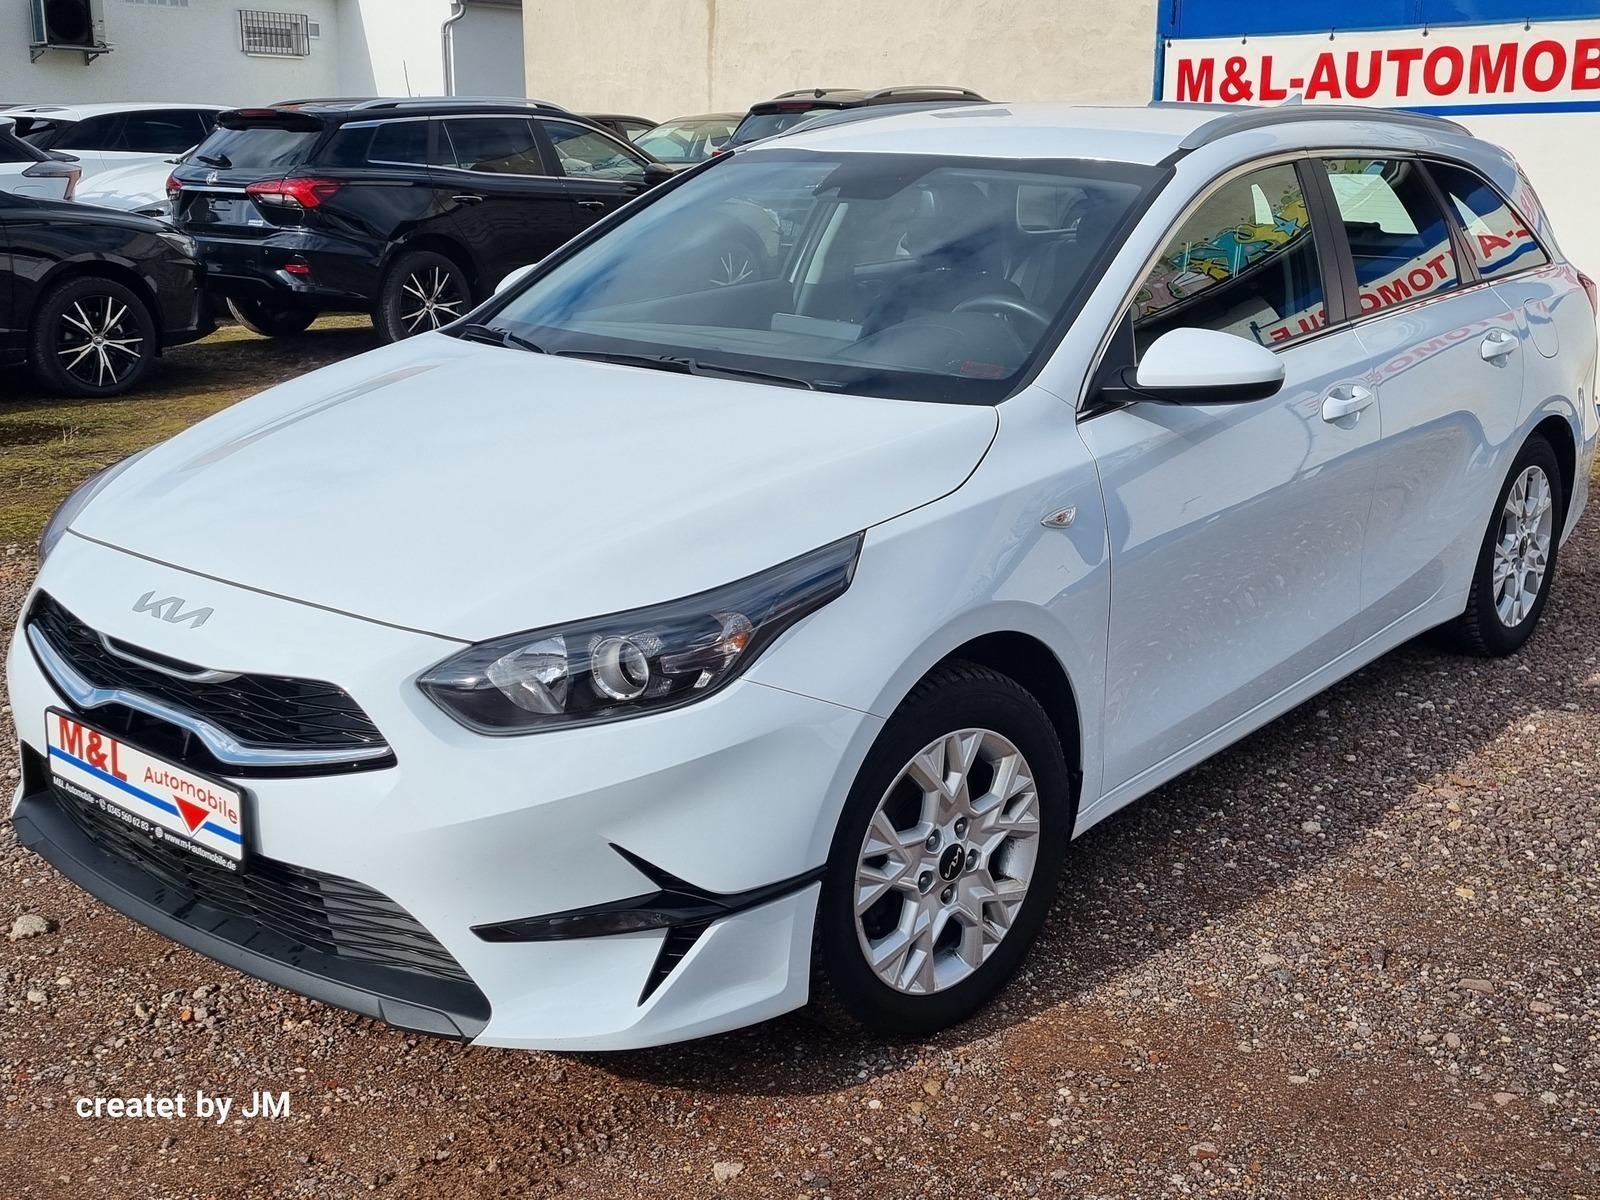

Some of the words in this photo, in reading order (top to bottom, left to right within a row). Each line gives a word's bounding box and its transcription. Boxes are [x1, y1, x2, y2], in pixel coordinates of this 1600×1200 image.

[132, 590, 215, 629] KIA
[59, 715, 127, 782] M&L
[143, 766, 238, 825] Automobile
